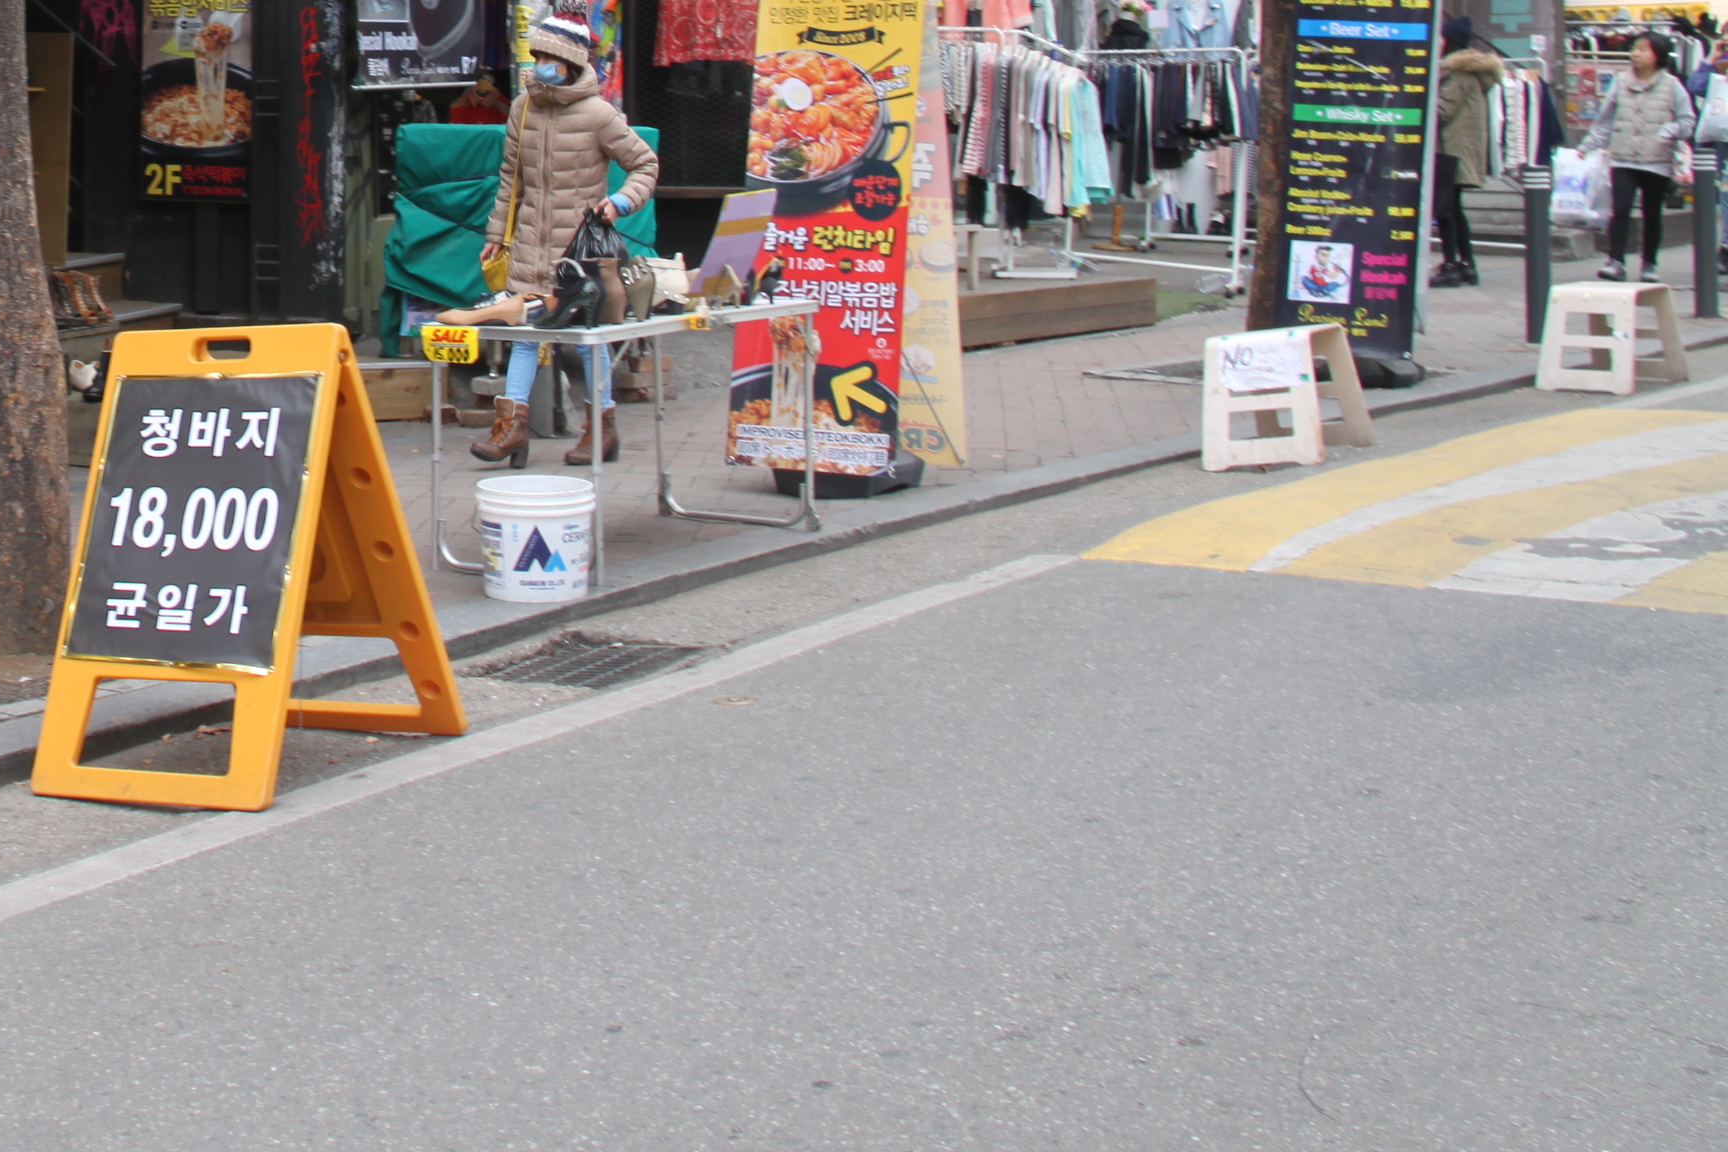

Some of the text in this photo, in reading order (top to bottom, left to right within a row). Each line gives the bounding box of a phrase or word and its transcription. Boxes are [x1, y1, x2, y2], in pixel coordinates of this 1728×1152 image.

[843, 1, 918, 22] 크레이지떡
[1329, 22, 1392, 38] Beer Set
[1325, 107, 1394, 124] Whisky Set
[144, 163, 182, 195] 2F
[812, 225, 895, 256] 런치타임
[854, 259, 886, 273] 3:00
[1361, 250, 1408, 267] Special
[1360, 269, 1408, 285] Hookah
[839, 310, 896, 337] 서비스
[430, 329, 469, 343] SALE
[140, 407, 281, 458] 청바지
[109, 486, 279, 558] 18,000
[105, 581, 248, 635] 균일가
